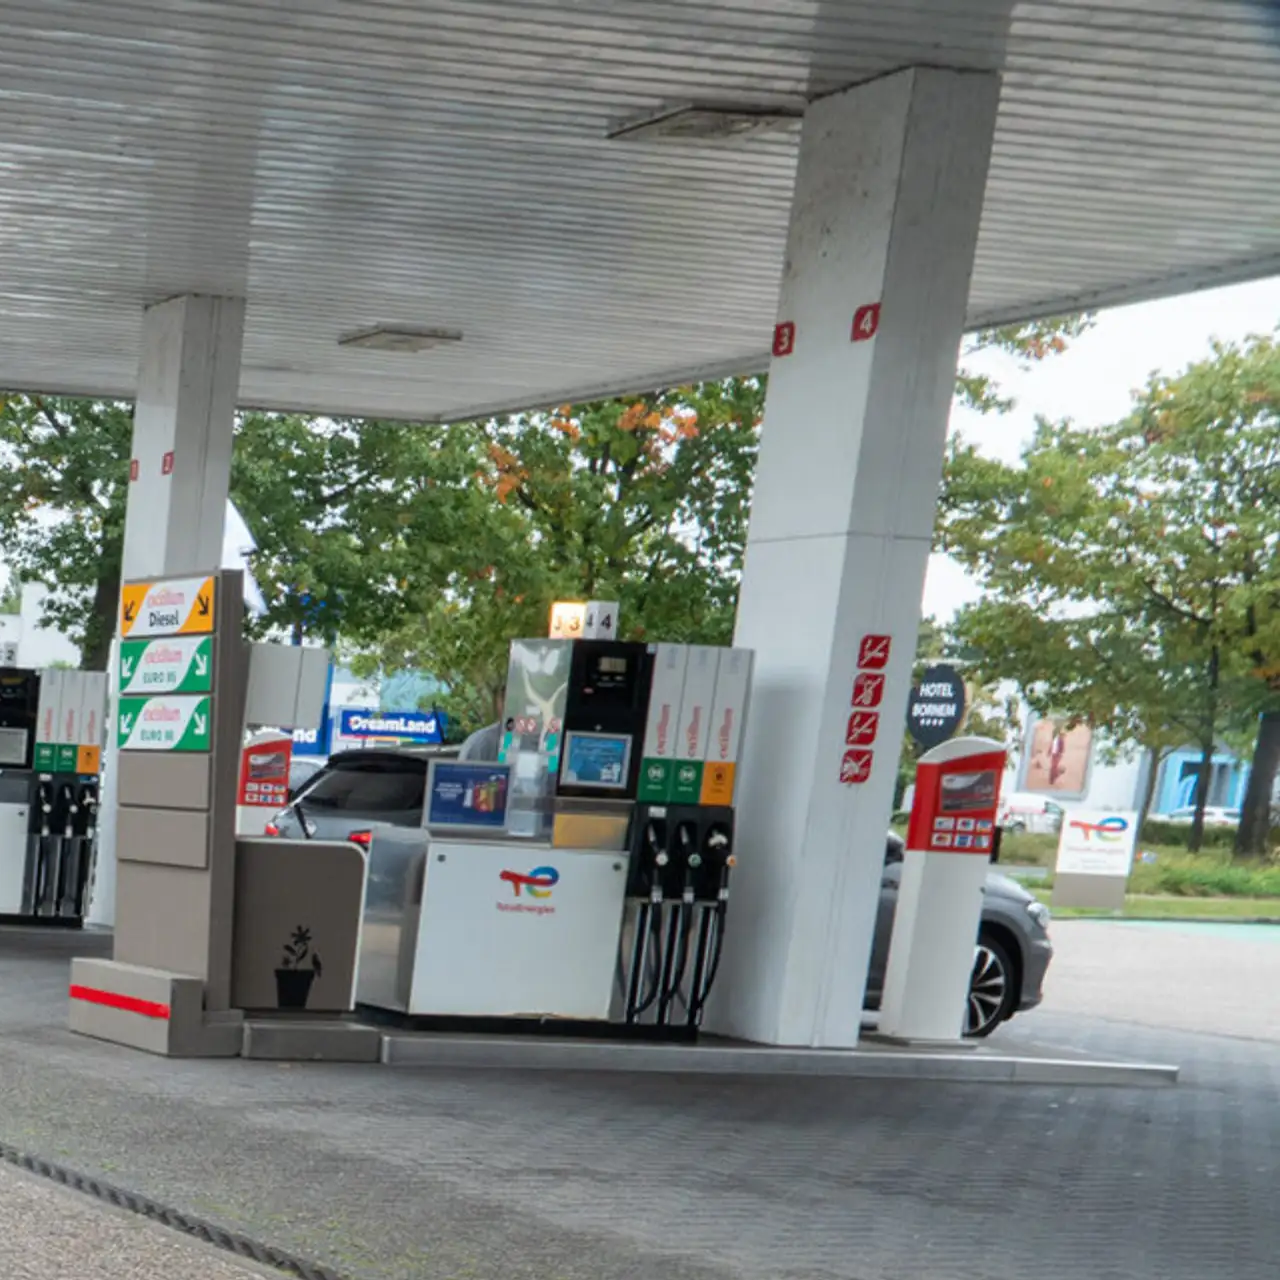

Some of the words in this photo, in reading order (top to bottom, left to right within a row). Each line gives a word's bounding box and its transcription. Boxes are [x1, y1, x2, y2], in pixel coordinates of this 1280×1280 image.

[860, 310, 873, 333] 4
[778, 327, 789, 352] 3
[149, 609, 179, 627] Diesel
[600, 612, 612, 631] 4
[920, 682, 954, 698] HOTEL
[348, 715, 436, 734] DreamLand
